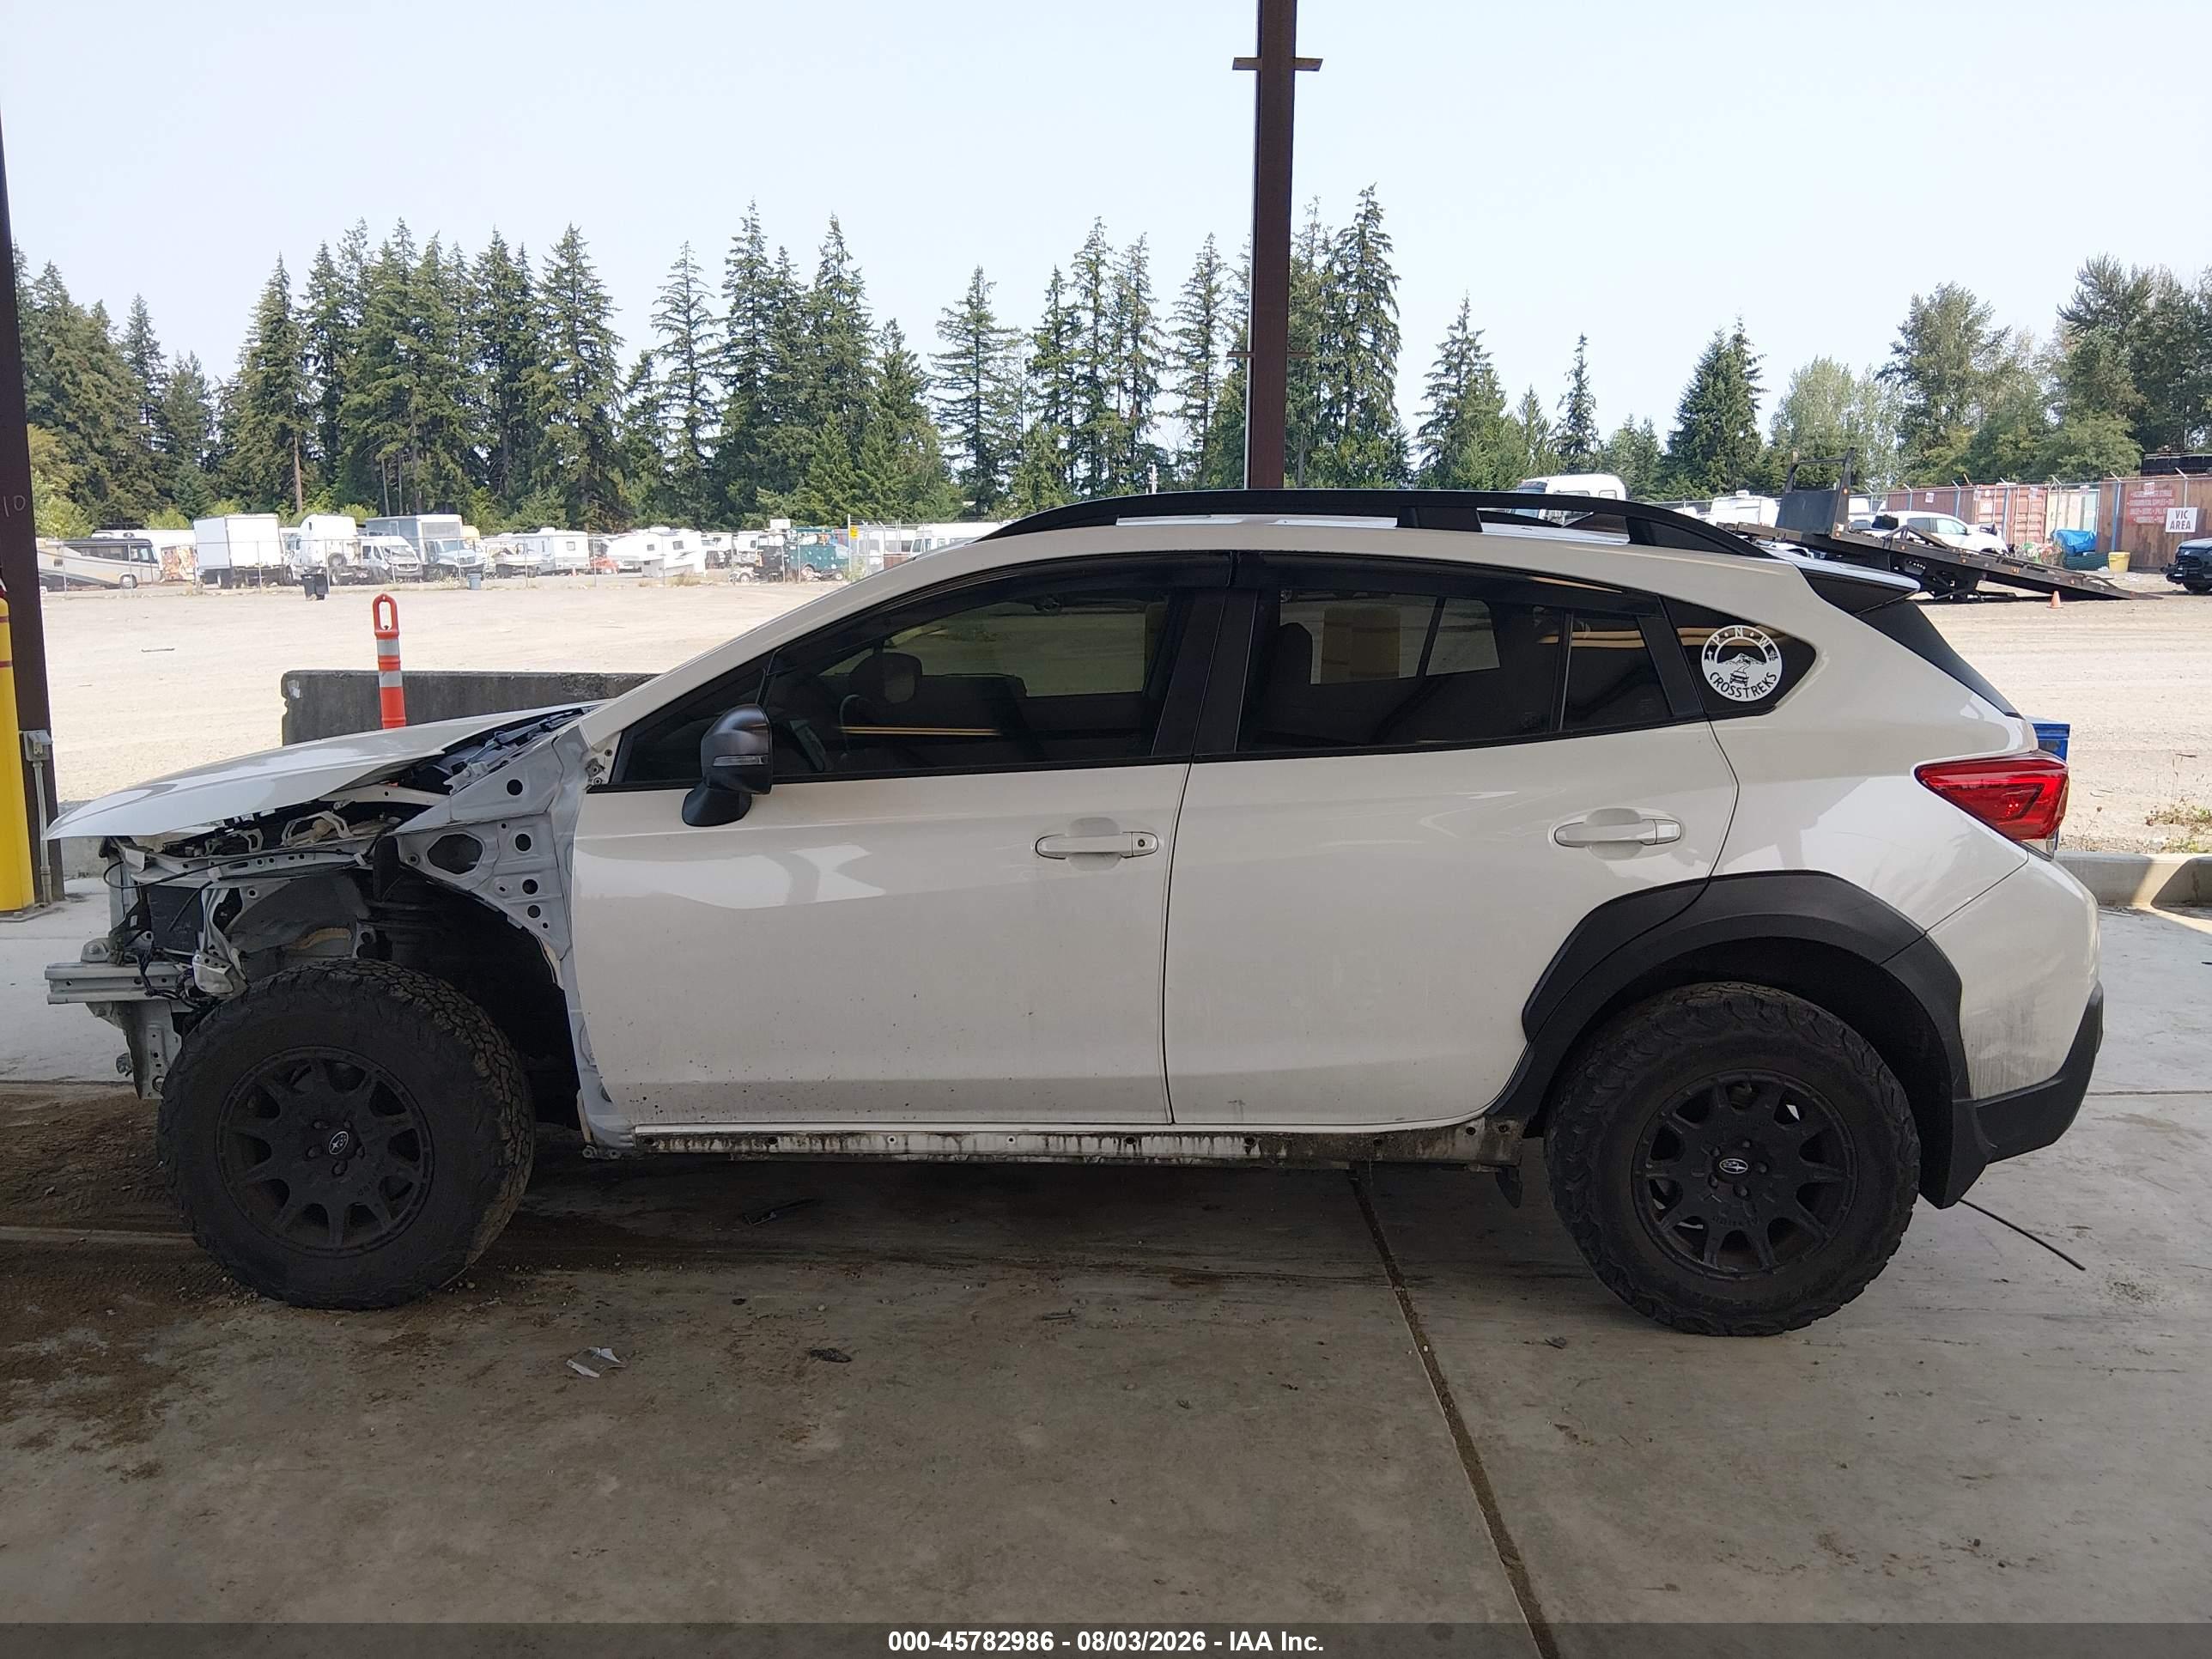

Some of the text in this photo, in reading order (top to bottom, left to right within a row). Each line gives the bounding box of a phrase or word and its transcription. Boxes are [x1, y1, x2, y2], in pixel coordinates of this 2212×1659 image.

[2175, 510, 2189, 520] VIC
[2169, 520, 2191, 530] AREA
[1709, 672, 1778, 699] CROSSTREKS
